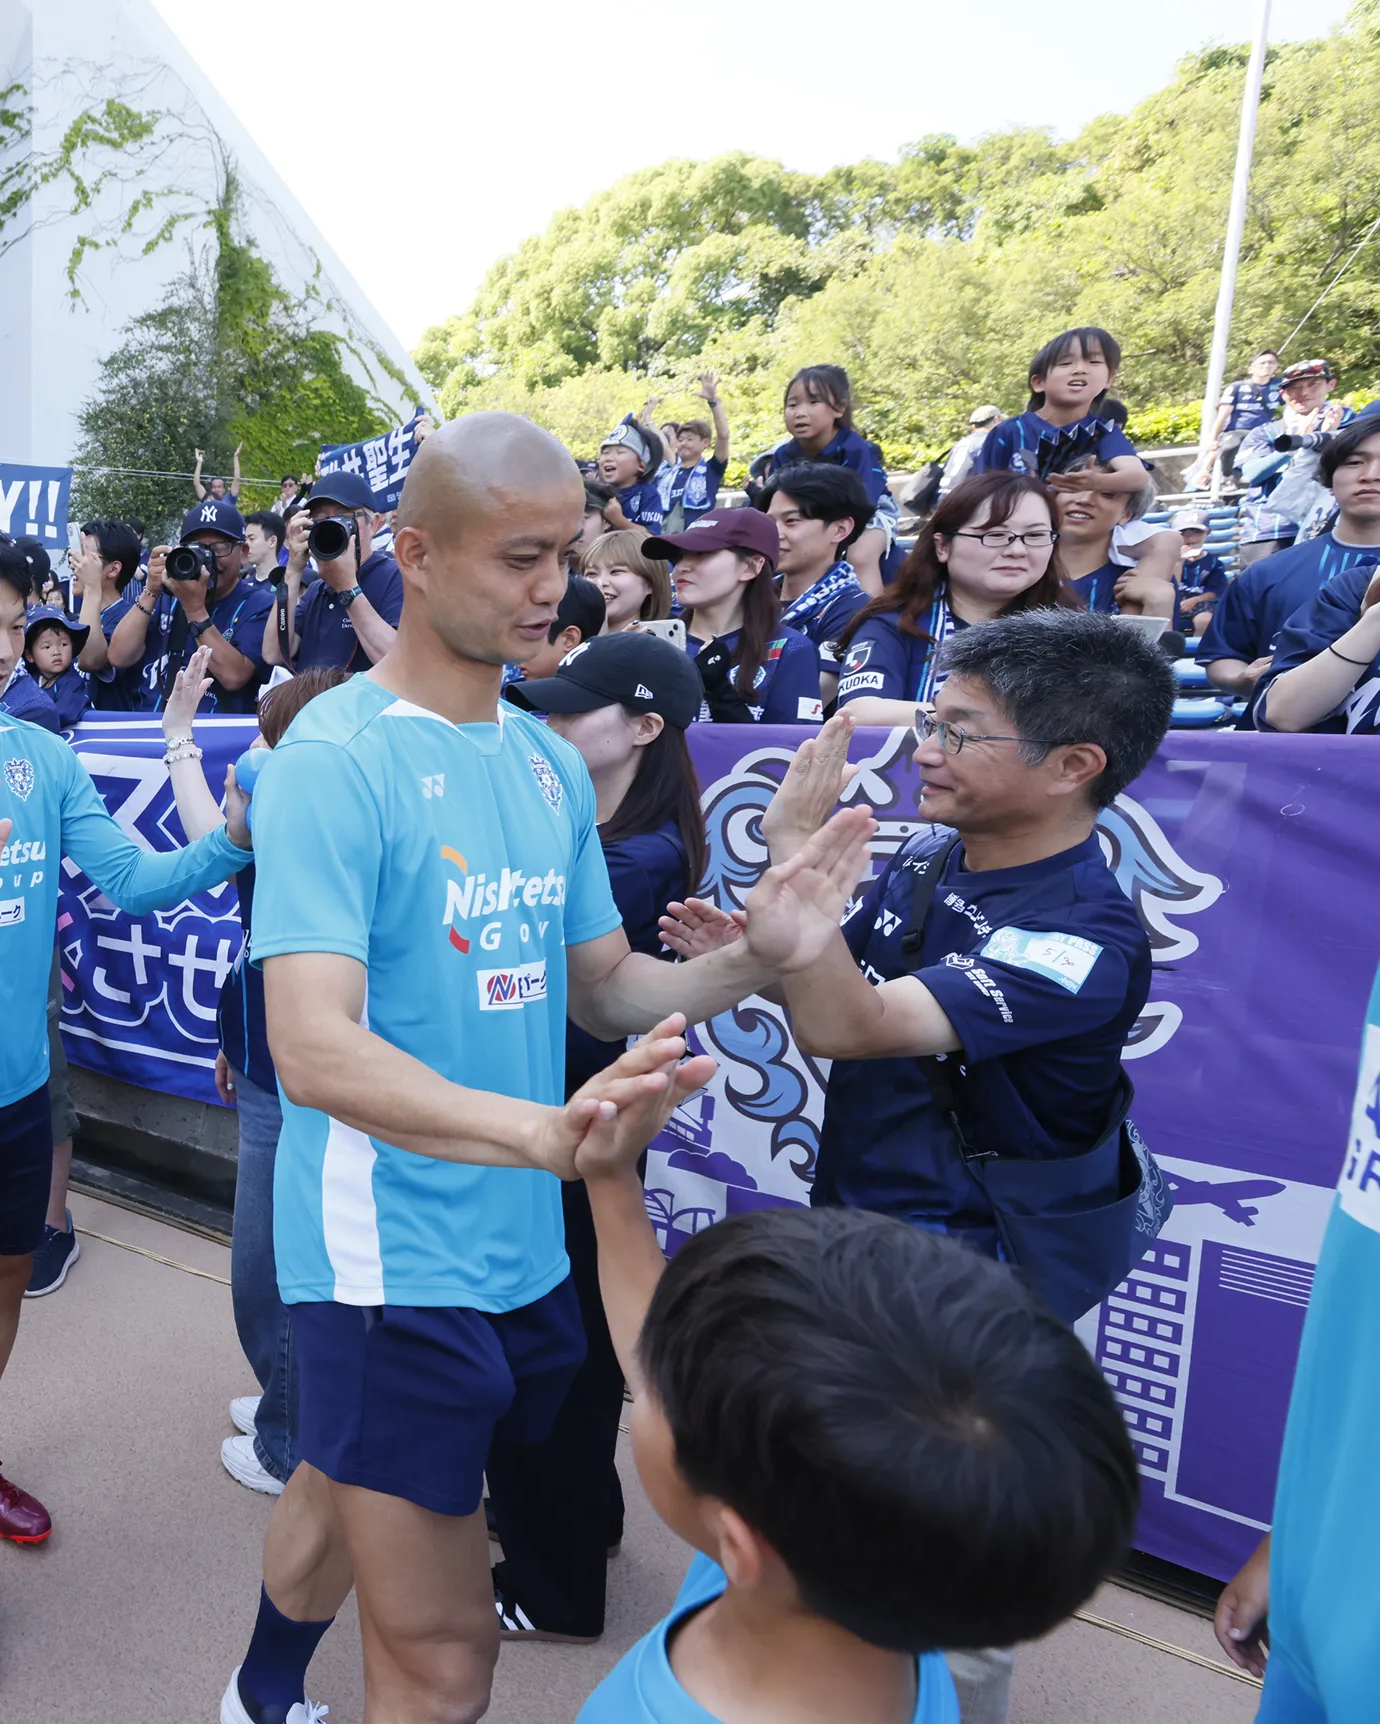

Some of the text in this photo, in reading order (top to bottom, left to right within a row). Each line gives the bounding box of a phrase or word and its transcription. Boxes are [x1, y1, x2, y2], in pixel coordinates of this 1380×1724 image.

[200, 505, 218, 522] NY
[1067, 937, 1099, 956] PASS
[971, 968, 1014, 1023] Soft Service
